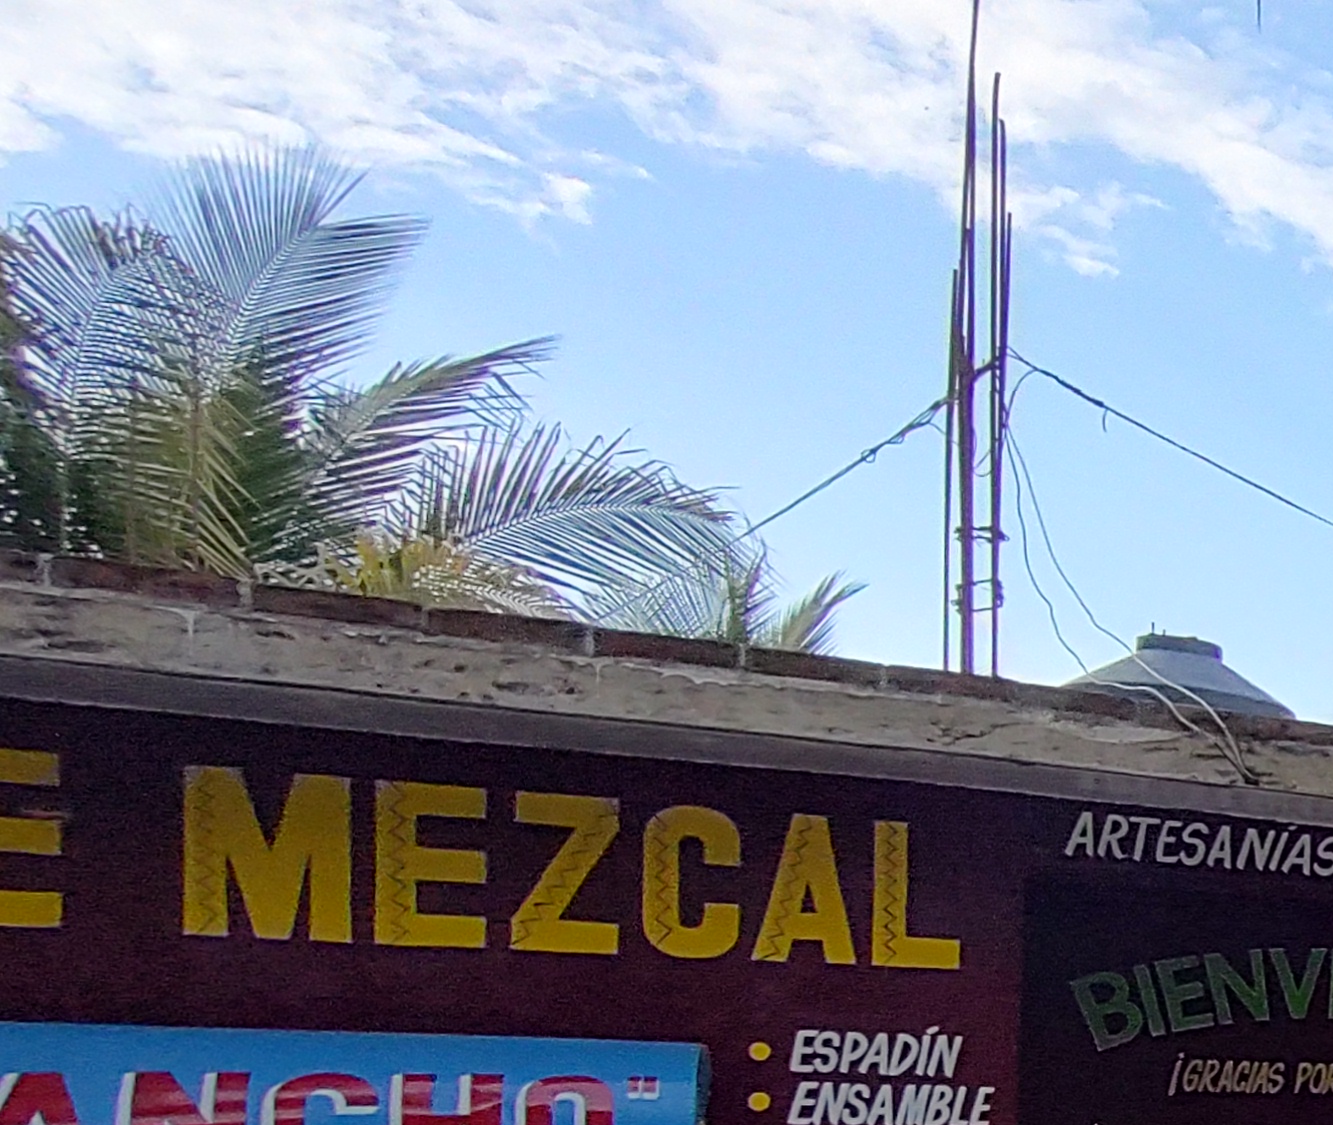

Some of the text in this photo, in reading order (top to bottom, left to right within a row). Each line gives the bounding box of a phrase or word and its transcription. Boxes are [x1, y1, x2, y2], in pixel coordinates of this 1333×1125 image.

[182, 764, 961, 971] MEZCAL
[789, 1026, 963, 1078] ESPADÍN
[1167, 1051, 1285, 1096] ¡GRACIAS
